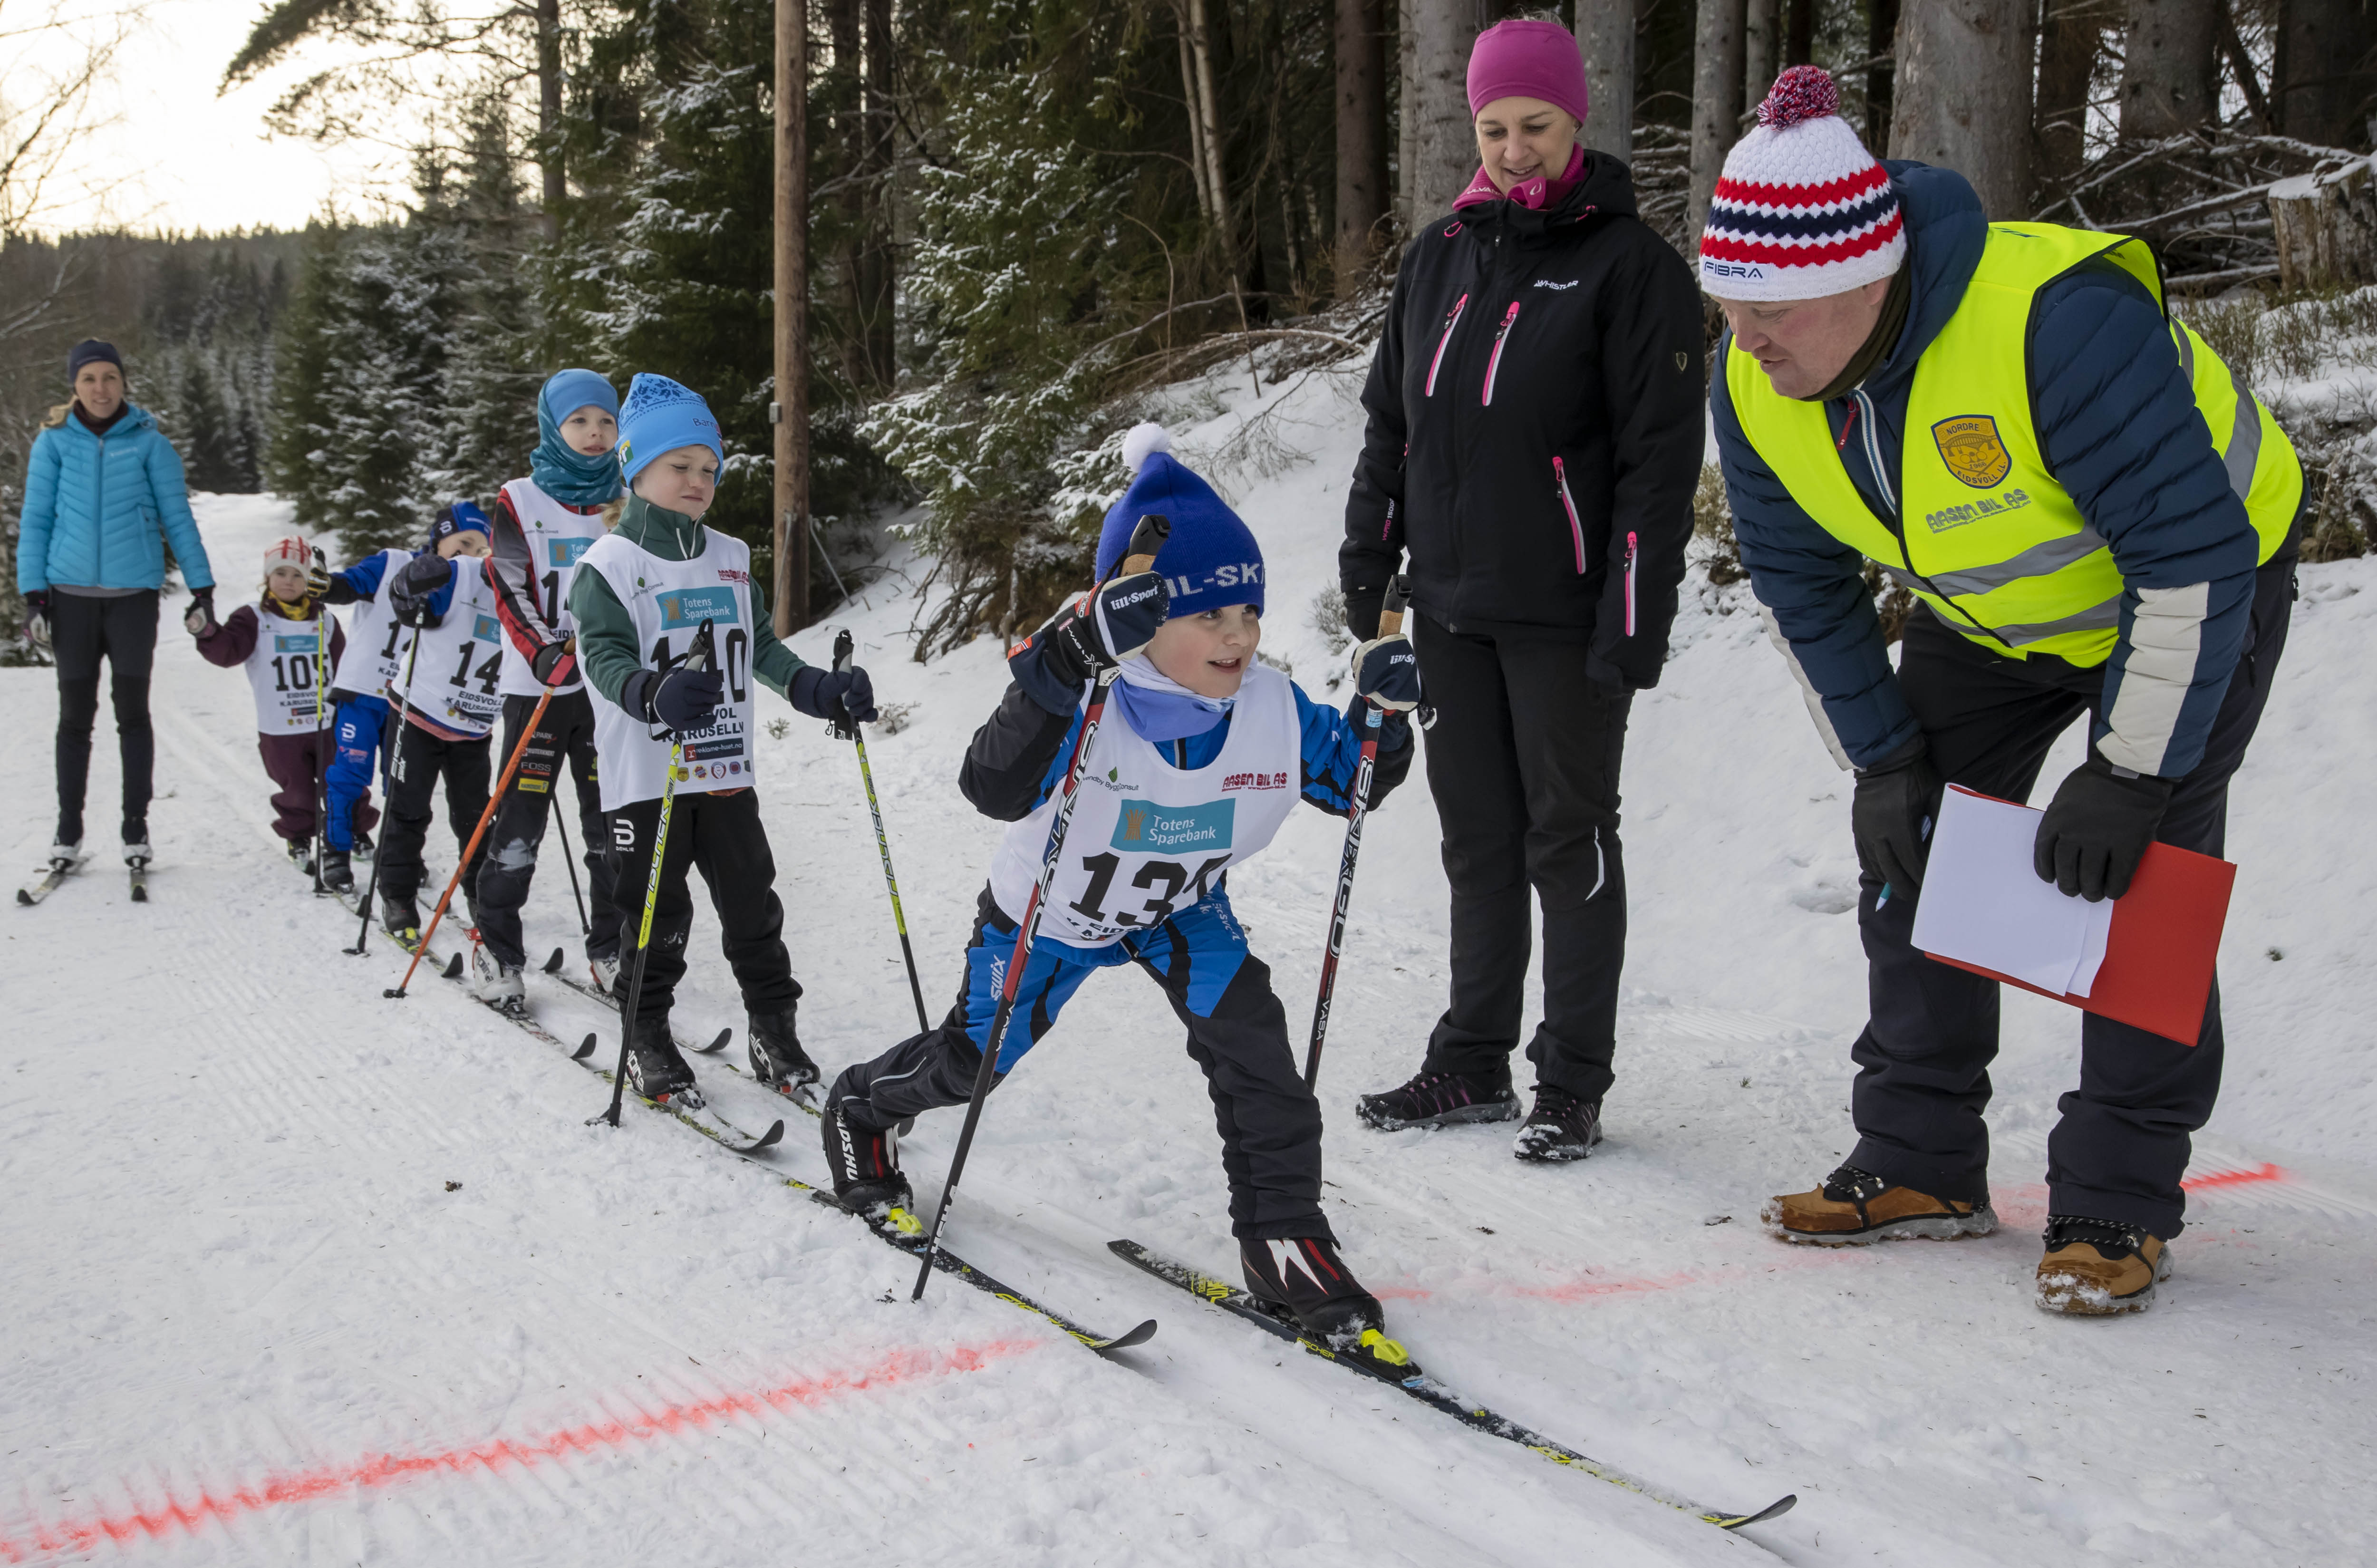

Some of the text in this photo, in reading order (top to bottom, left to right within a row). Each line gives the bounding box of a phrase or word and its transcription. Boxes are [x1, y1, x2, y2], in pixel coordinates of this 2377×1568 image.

[1704, 261, 1763, 279] FIBRA
[1534, 280, 1578, 290] WHISTLER
[1946, 423, 1979, 436] NORDRE
[1957, 470, 1998, 484] EIDSVOLL
[1925, 488, 2029, 530] AASEN BIL AS
[683, 598, 712, 608] Totens
[684, 605, 731, 621] Sparebank
[271, 654, 329, 691] 105
[449, 640, 503, 696] 14
[521, 762, 551, 772] FOSS
[1223, 772, 1287, 788] AASEN BIL AS
[666, 777, 675, 803] SPRINT
[1153, 814, 1195, 832] Totens
[1149, 826, 1217, 846] Sparebank
[645, 802, 670, 910] FISCHER
[868, 797, 899, 897] FISCHER
